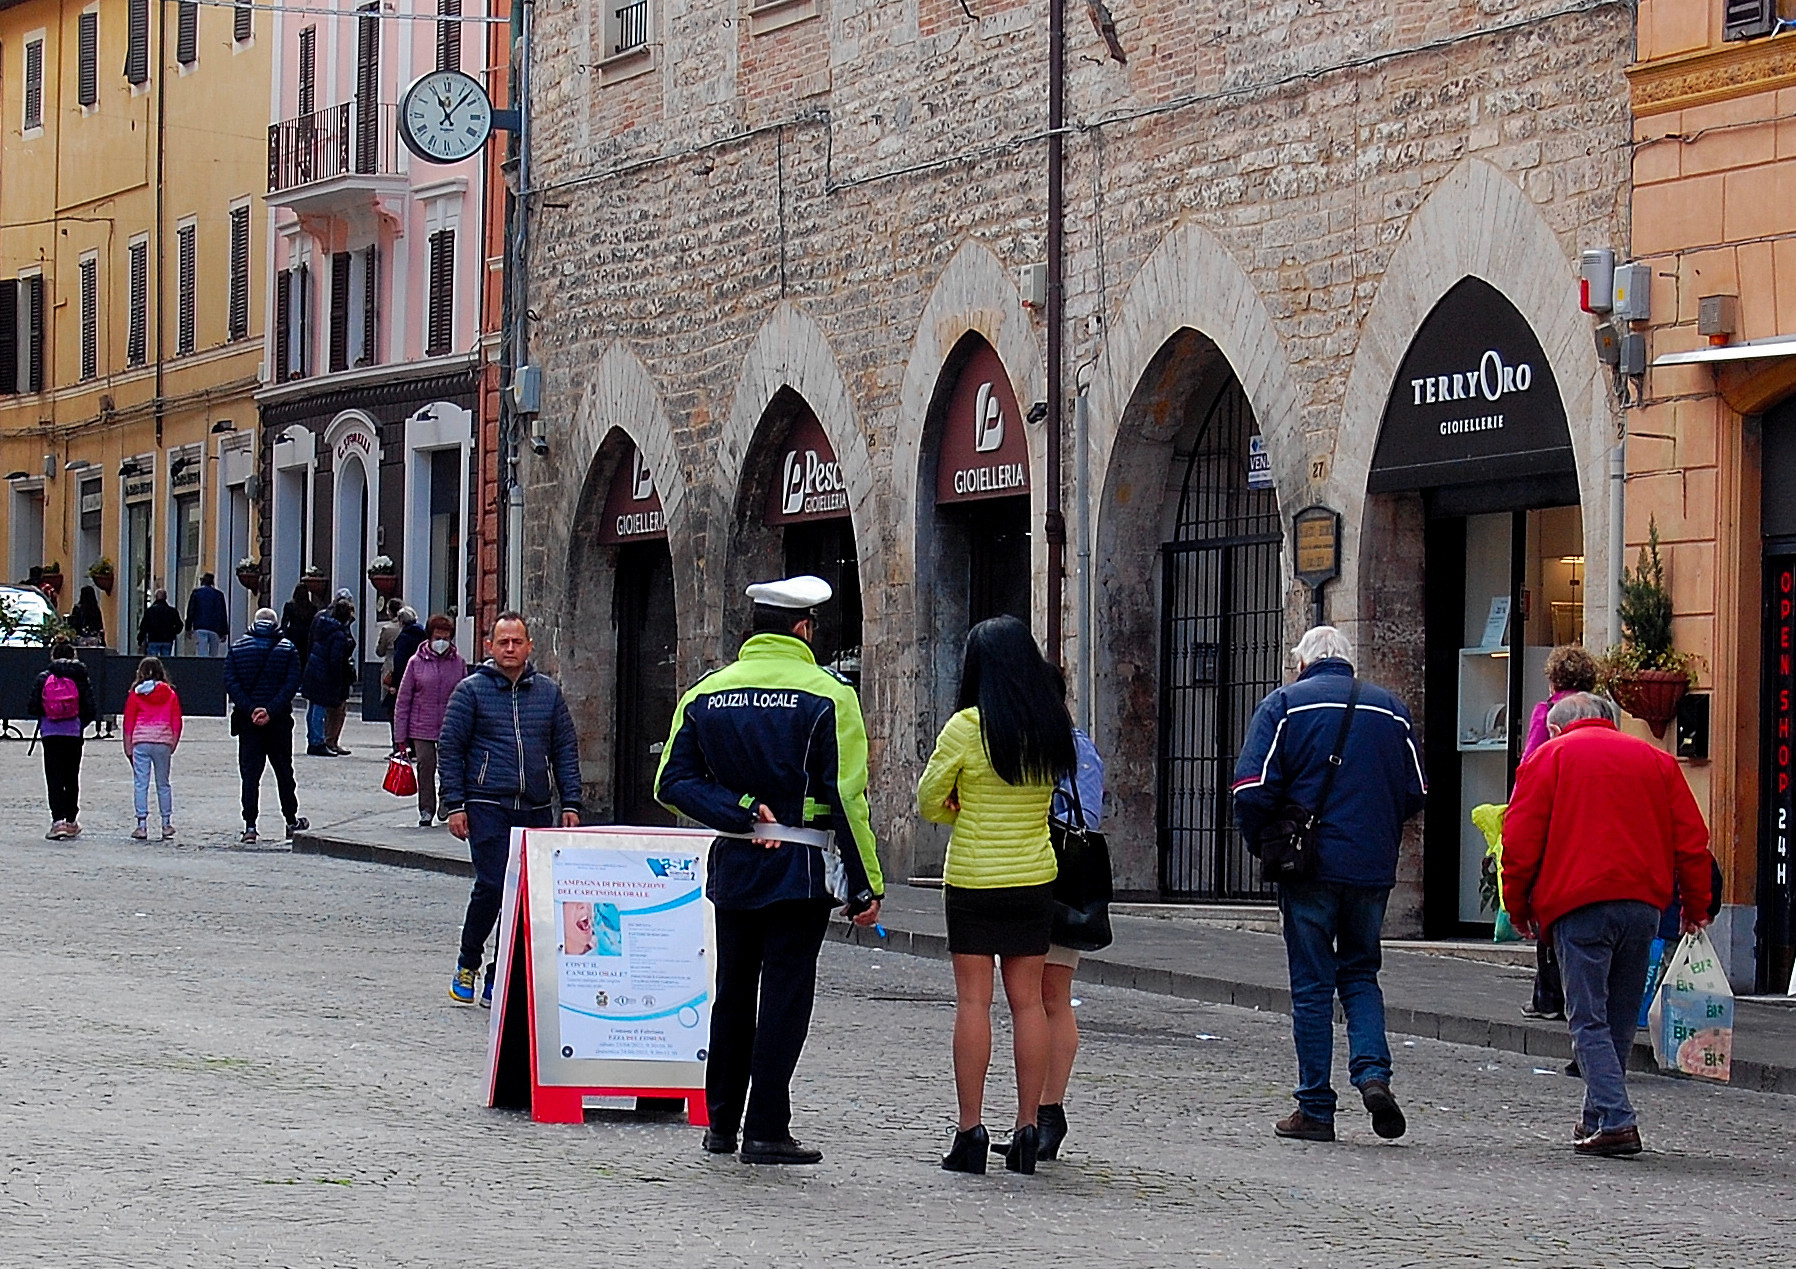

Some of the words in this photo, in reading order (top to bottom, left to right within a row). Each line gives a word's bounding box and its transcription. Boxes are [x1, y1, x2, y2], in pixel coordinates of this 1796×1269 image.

[1440, 415, 1504, 435] GIOIELLERIE
[805, 450, 845, 493] Pesc
[954, 463, 1025, 494] GIOIELLERIA
[1312, 461, 1324, 478] 27
[805, 493, 847, 513] GIOIELLERIA
[1779, 571, 1791, 675] OPEN
[707, 693, 749, 710] POLIZIA
[753, 692, 799, 708] LOCALE
[1778, 689, 1790, 794] SHOP
